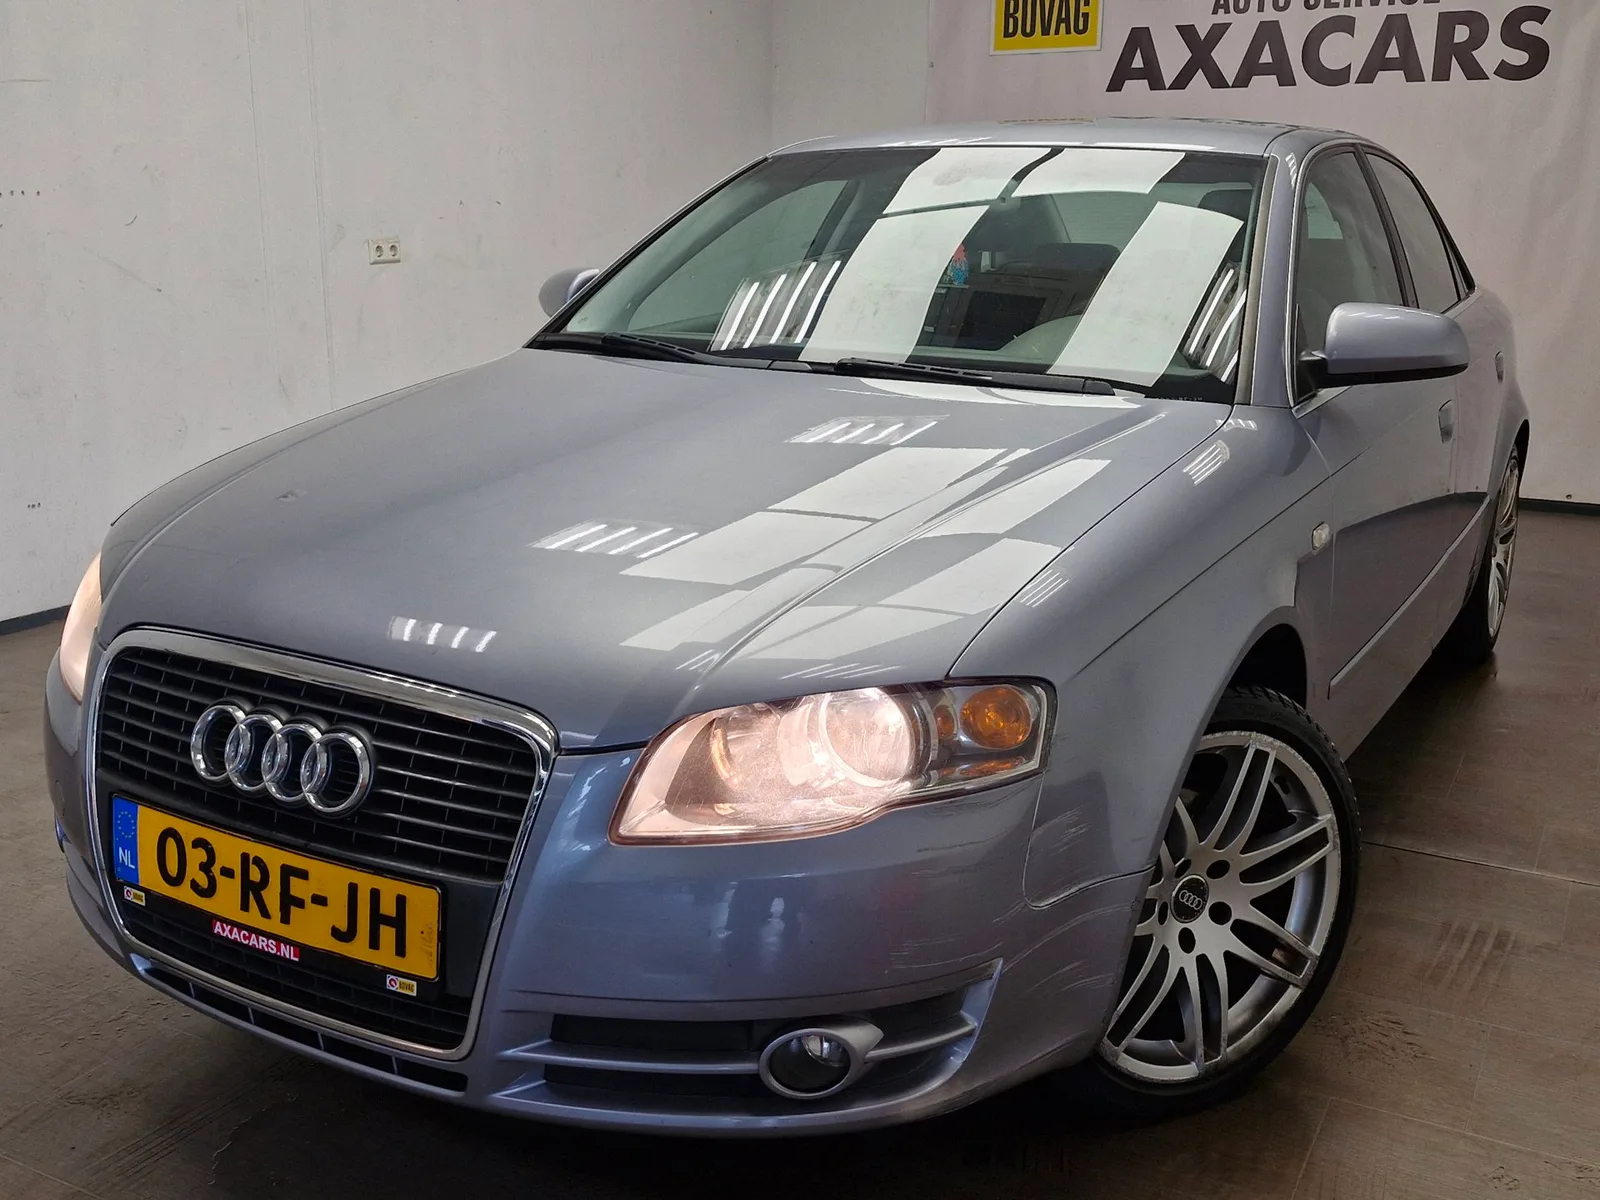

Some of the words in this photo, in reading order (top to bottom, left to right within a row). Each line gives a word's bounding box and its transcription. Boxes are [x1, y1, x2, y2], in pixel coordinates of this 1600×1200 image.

[1003, 0, 1091, 38] BOVAG
[1105, 5, 1551, 93] AXACARS
[118, 846, 136, 869] NL
[156, 826, 407, 959] 03-RF-JH
[213, 921, 300, 962] AXACARS.NL
